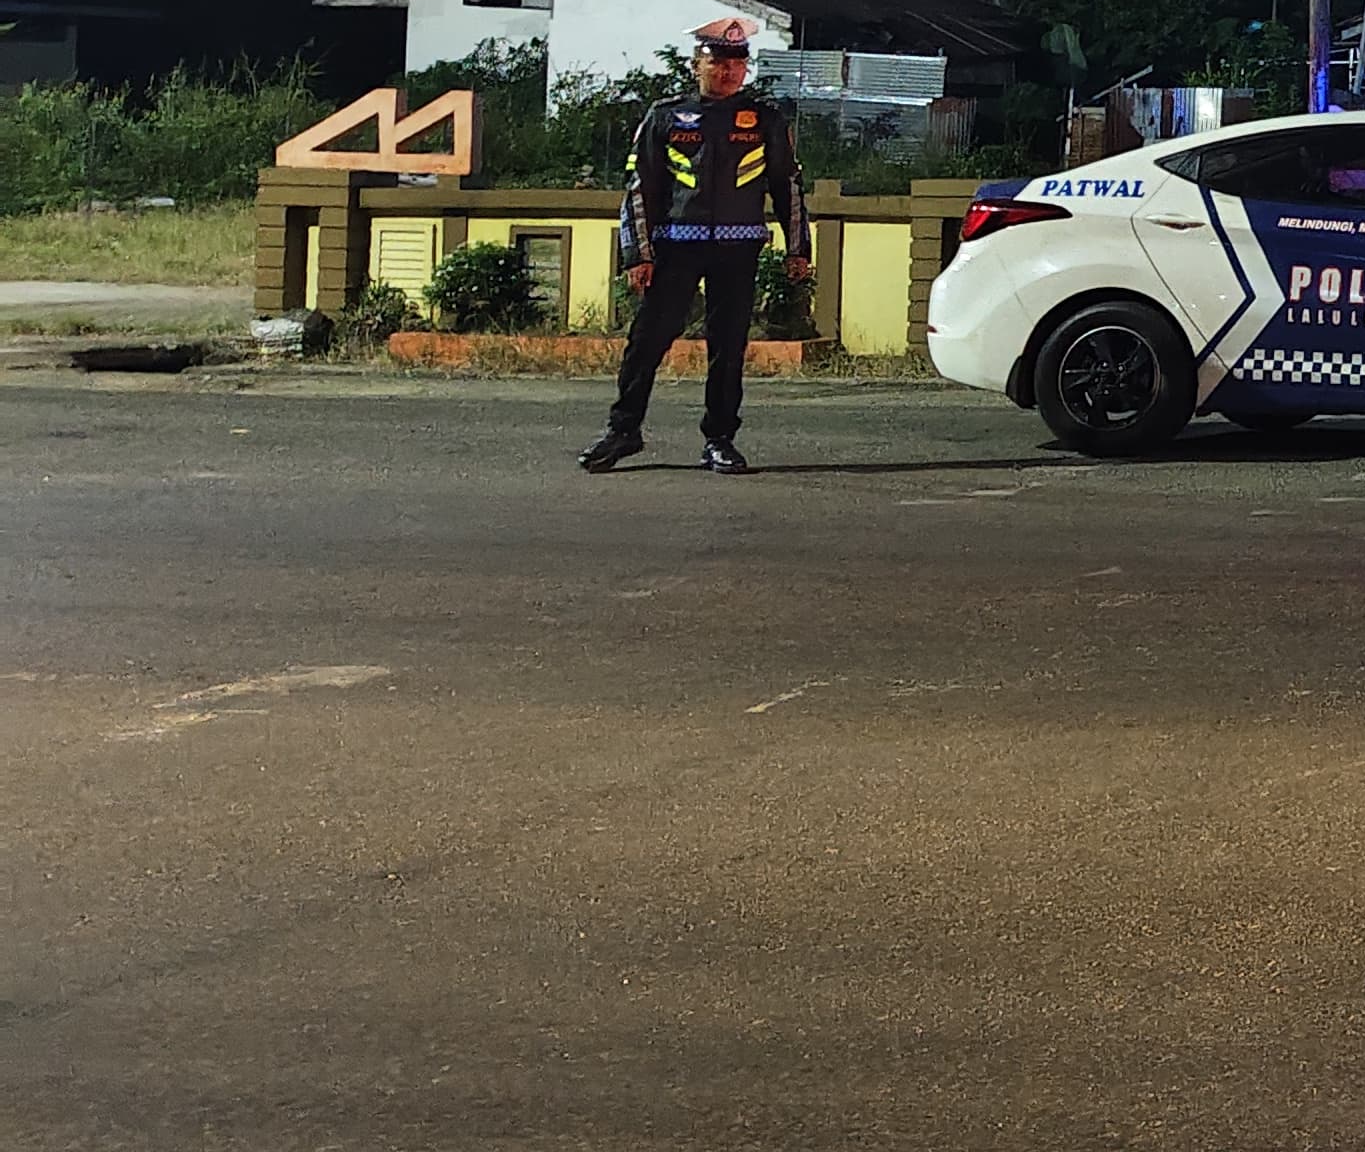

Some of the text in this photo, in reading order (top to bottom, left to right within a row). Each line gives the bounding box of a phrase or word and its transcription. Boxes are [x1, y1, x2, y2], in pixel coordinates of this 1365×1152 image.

[1041, 180, 1145, 197] PATWAL
[1278, 217, 1356, 234] MELINDUNGI,
[1287, 307, 1341, 326] LALU
